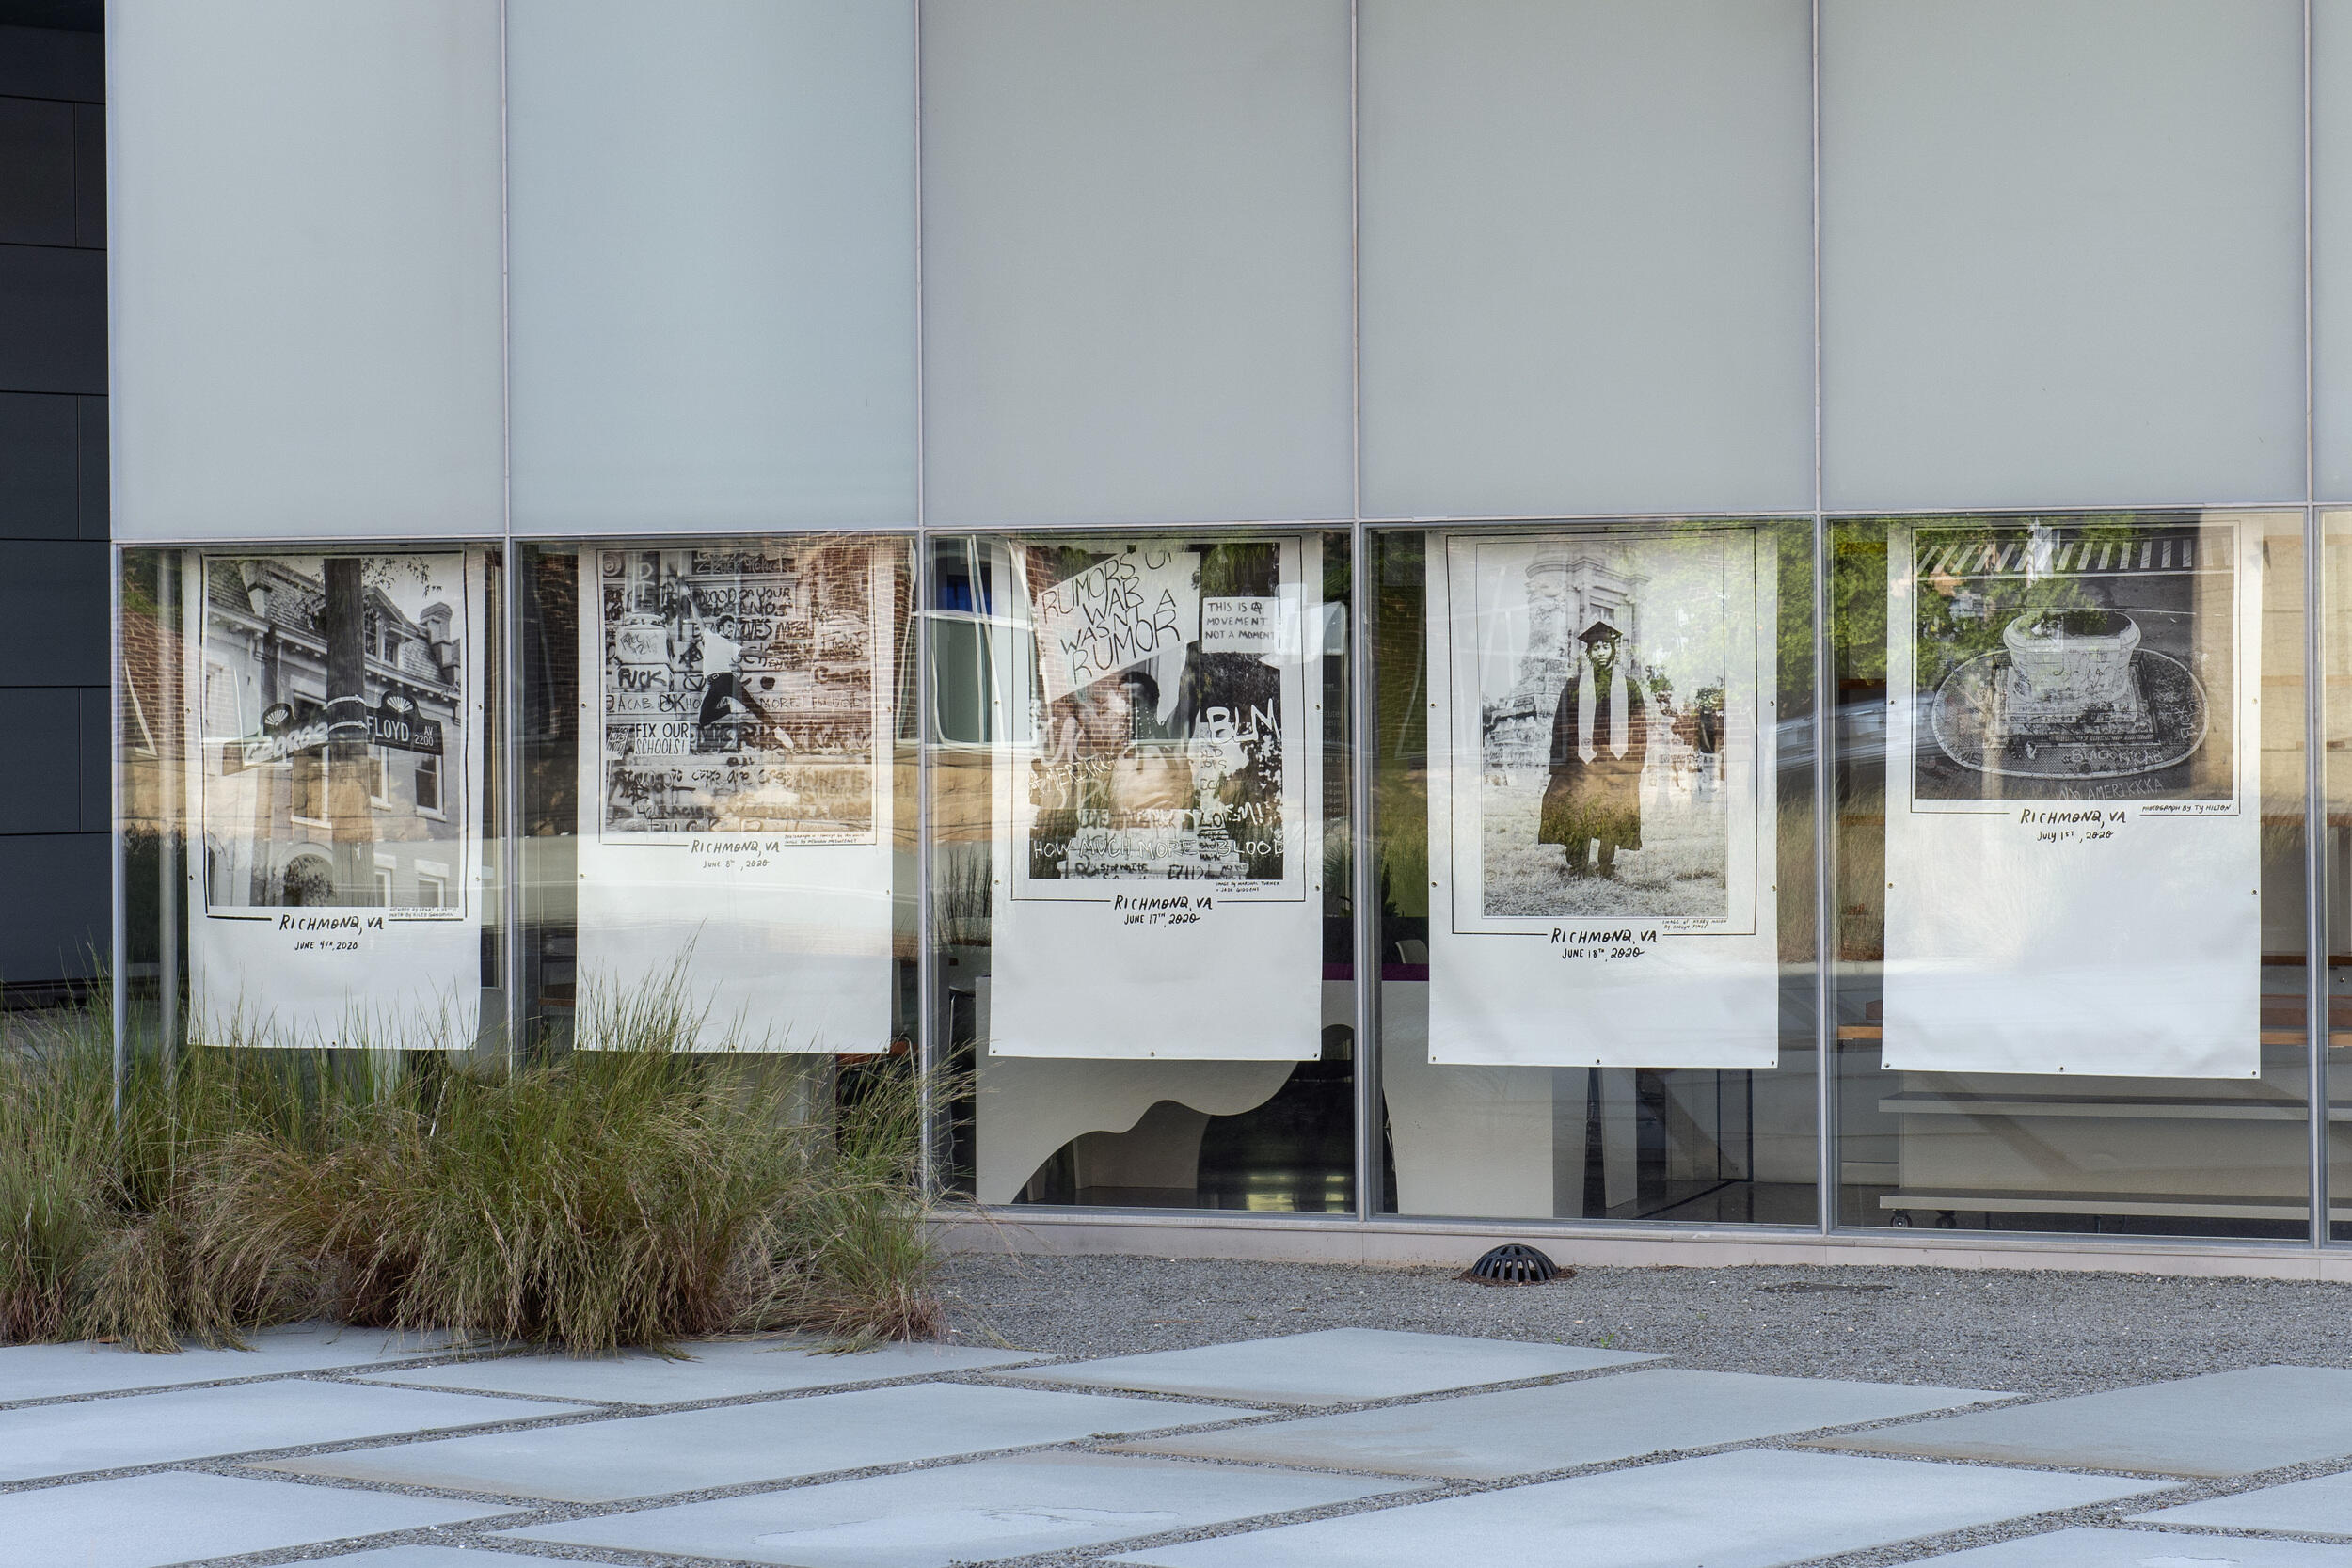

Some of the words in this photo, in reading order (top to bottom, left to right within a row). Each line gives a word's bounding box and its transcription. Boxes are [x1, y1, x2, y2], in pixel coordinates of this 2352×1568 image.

[757, 587, 791, 602] YOUR
[1041, 552, 1136, 625] RUMORS
[1156, 589, 1177, 613] A
[1207, 601, 1232, 612] THIS
[1238, 602, 1248, 612] IS
[1206, 617, 1268, 626] MOVEMENT
[1205, 630, 1225, 640] NOT
[1238, 630, 1275, 640] MOMENT
[1072, 609, 1181, 686] RUMOR
[1206, 698, 1281, 745] BLM
[367, 715, 409, 742] FLOYD
[423, 725, 433, 736] AV
[635, 722, 657, 738] FIX
[662, 722, 689, 738] OUR
[415, 735, 434, 747] 2200
[634, 738, 686, 755] SCHOOLS!
[2109, 811, 2126, 824] VA
[2086, 831, 2114, 840] 2020
[765, 841, 780, 853] VA
[1033, 839, 1072, 859] HOW
[1079, 837, 1132, 858] MUCH
[1138, 839, 1198, 860] MORE
[703, 860, 720, 869] JUNE
[746, 860, 770, 868] 2020
[1197, 897, 1213, 910] VA
[367, 916, 384, 930] VA
[1124, 914, 1145, 926] JUNE
[1168, 913, 1200, 925] 2020
[1641, 929, 1658, 942] VA
[294, 942, 315, 951] JUNE
[336, 942, 358, 950] 2020
[1562, 948, 1584, 959] JUNE
[1610, 947, 1645, 958] 2020
